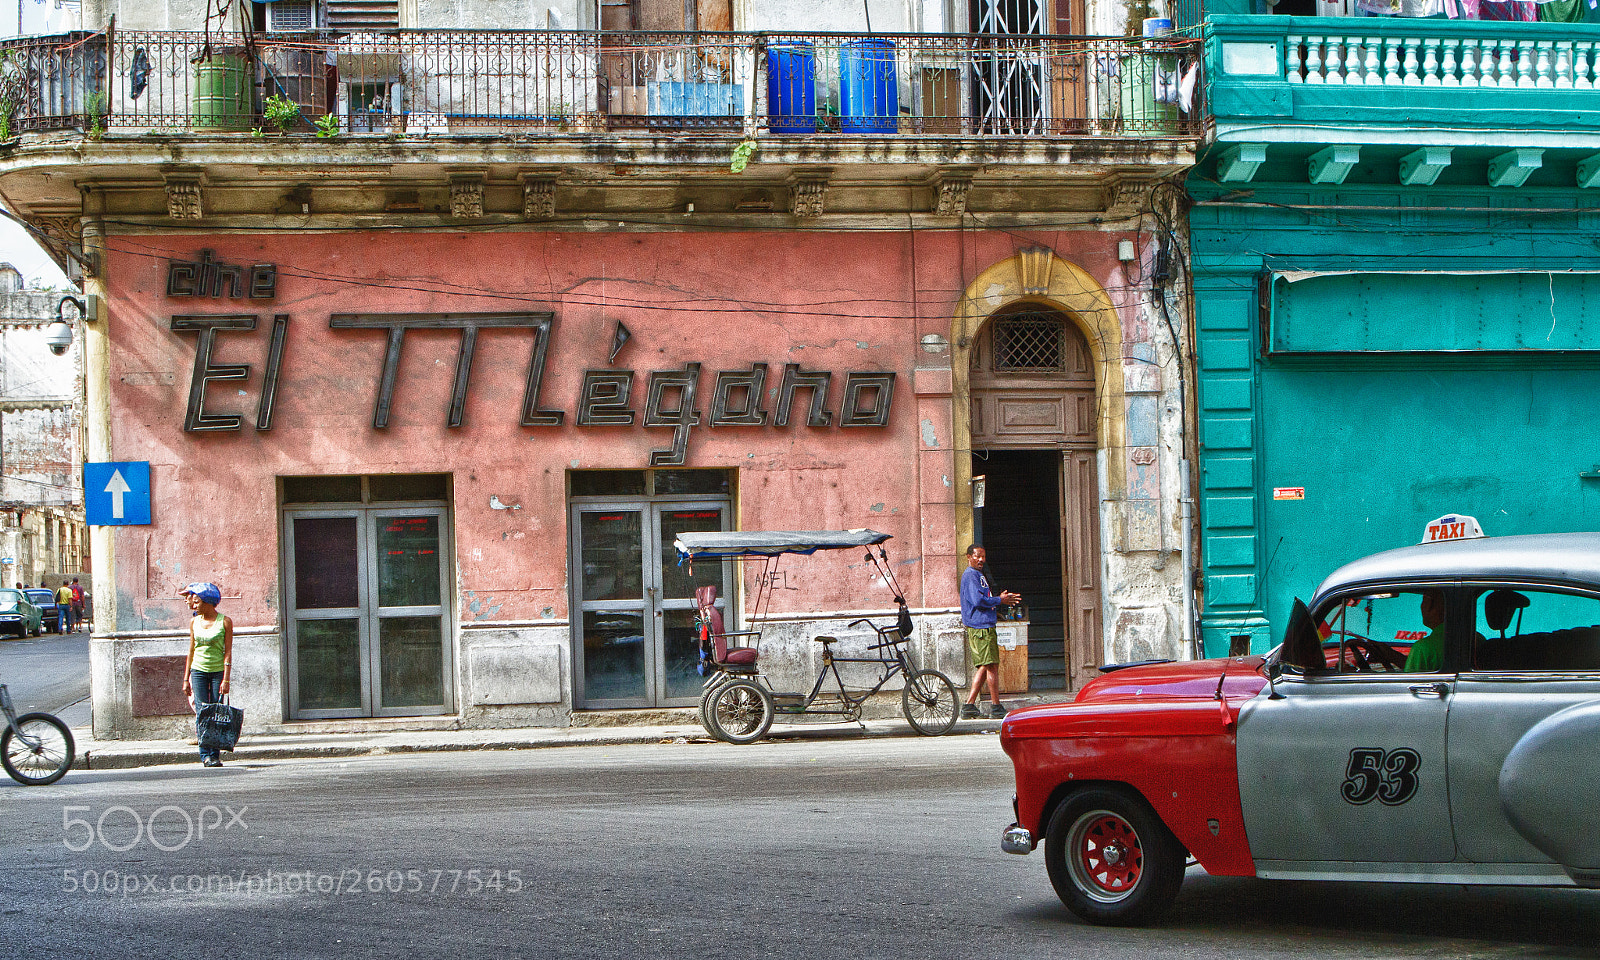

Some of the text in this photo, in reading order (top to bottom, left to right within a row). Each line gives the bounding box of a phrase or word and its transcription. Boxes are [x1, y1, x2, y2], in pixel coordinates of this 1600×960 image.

[166, 249, 278, 300] cine
[170, 314, 290, 432] El
[1428, 522, 1466, 541] TAXI
[1340, 746, 1422, 806] 53
